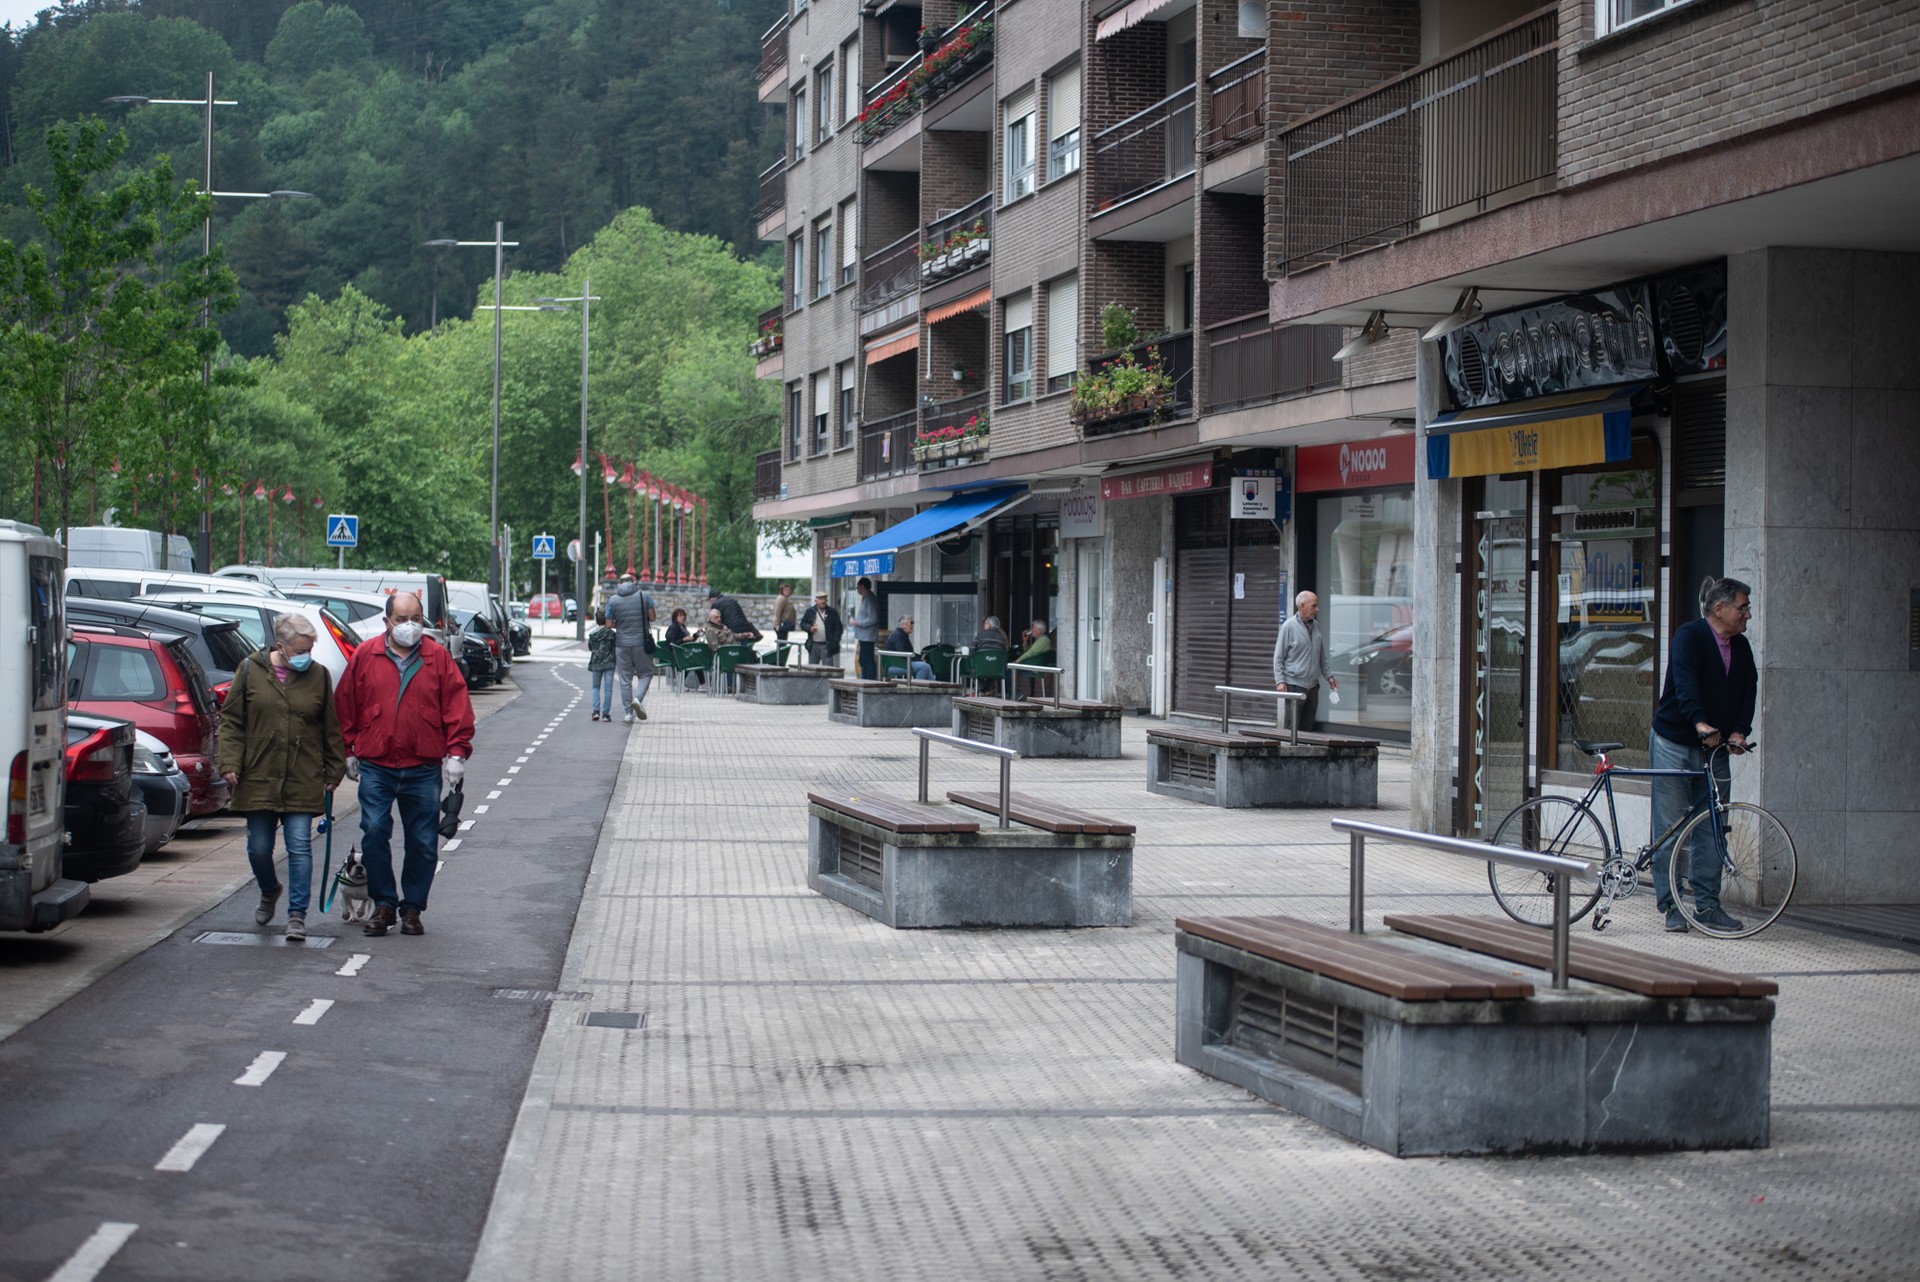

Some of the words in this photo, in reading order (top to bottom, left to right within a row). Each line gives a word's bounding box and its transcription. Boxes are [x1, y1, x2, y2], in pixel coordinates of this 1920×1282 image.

[1120, 481, 1132, 495] BAR
[1136, 476, 1164, 493] CAFETERIA
[1475, 535, 1486, 829] HARATEGIA
